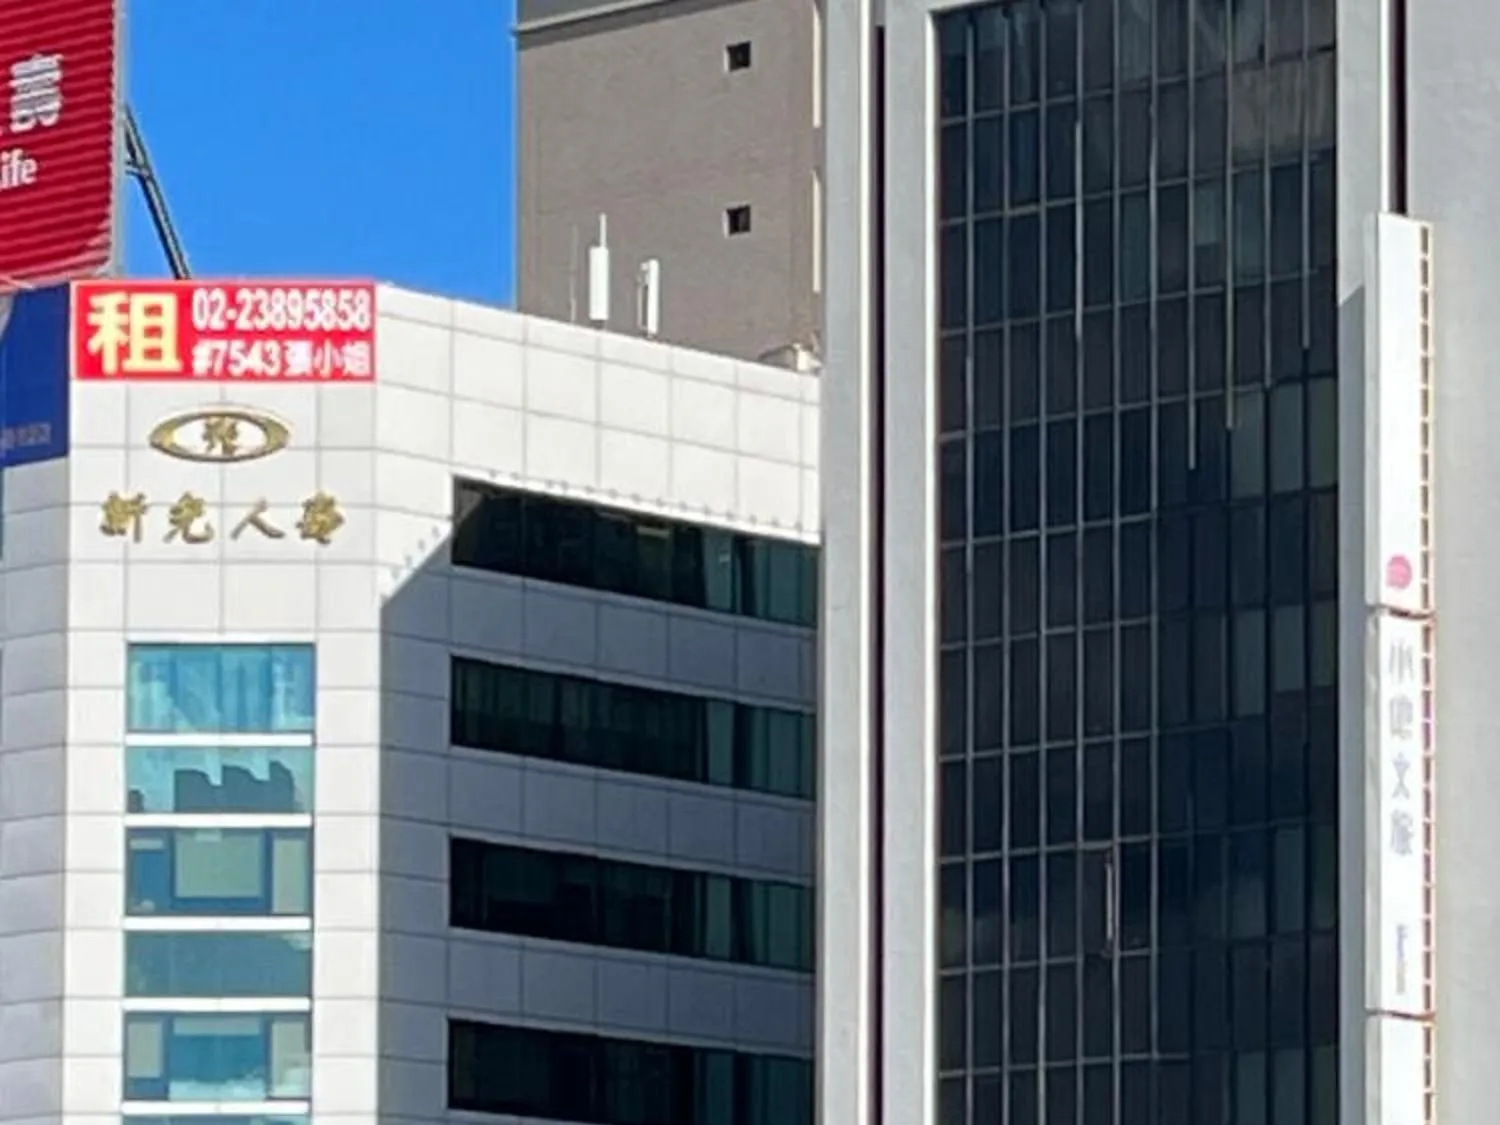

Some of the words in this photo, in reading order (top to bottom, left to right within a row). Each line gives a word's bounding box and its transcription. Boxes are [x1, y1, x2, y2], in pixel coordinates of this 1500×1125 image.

[0, 53, 64, 134] 壽
[0, 147, 38, 190] ife
[86, 291, 183, 376] 租
[191, 287, 372, 332] 02-23895858
